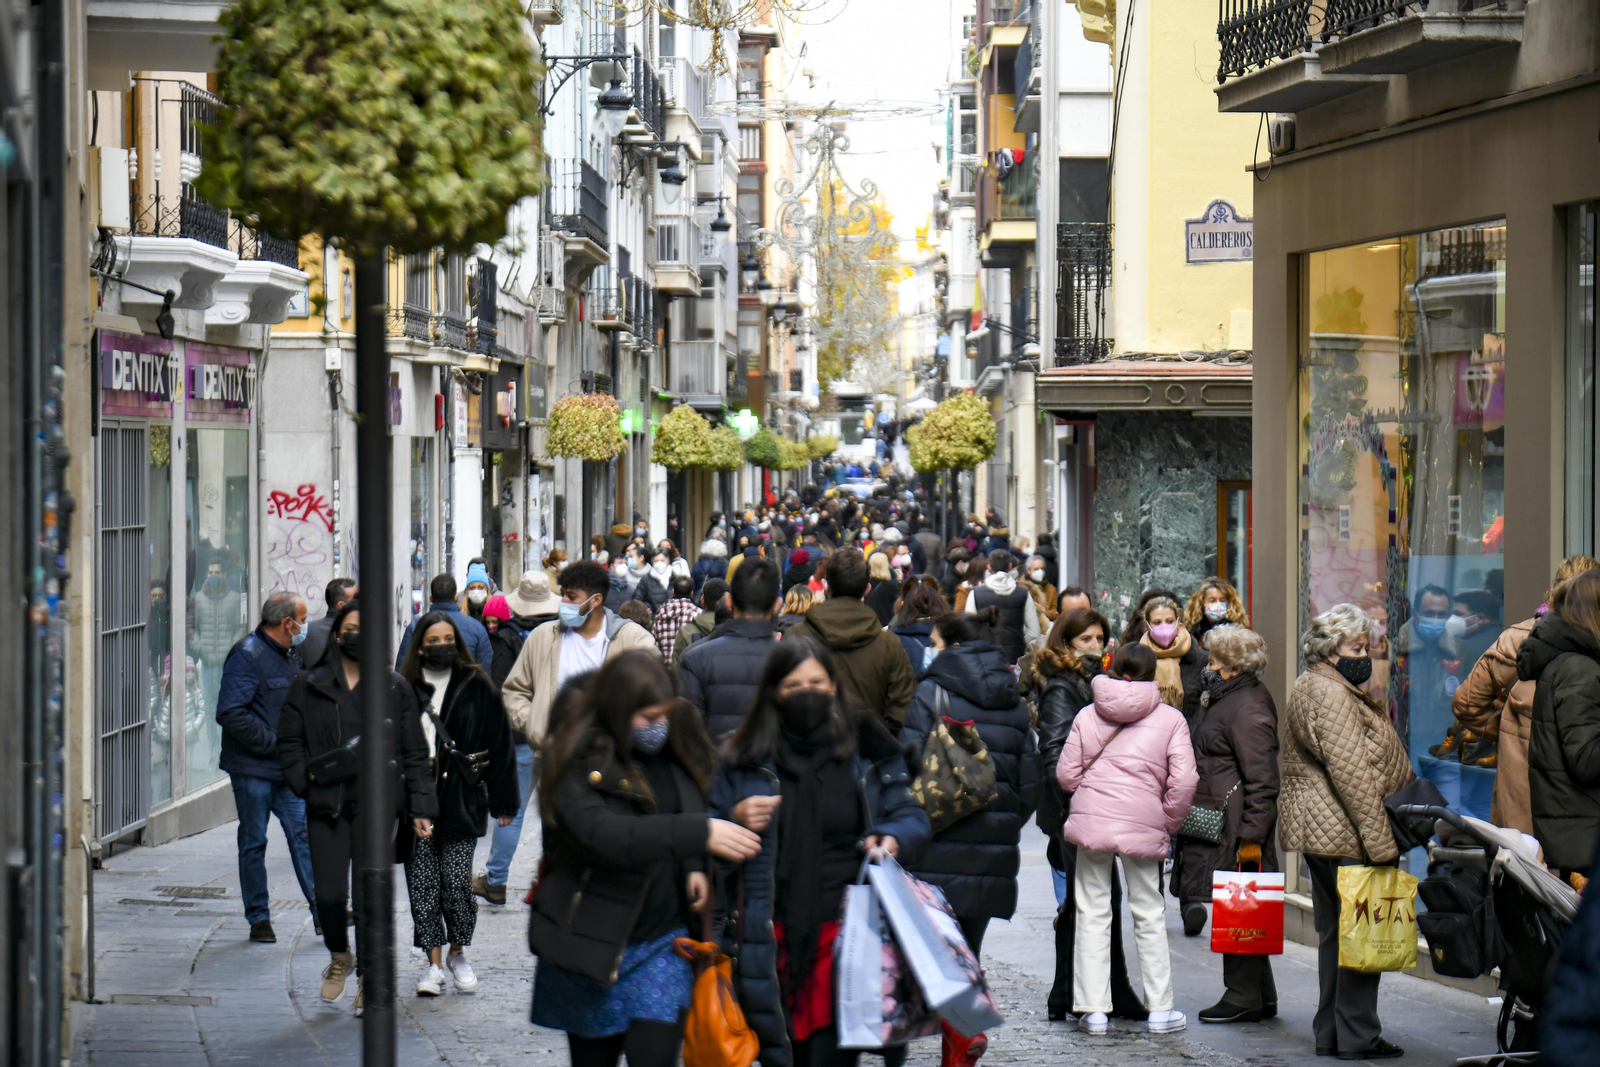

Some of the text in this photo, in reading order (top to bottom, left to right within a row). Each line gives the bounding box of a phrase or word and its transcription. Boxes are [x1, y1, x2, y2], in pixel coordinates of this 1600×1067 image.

[1190, 230, 1252, 249] CALDEREROS
[112, 349, 164, 394] DENTIX
[203, 363, 244, 402] DENTIX
